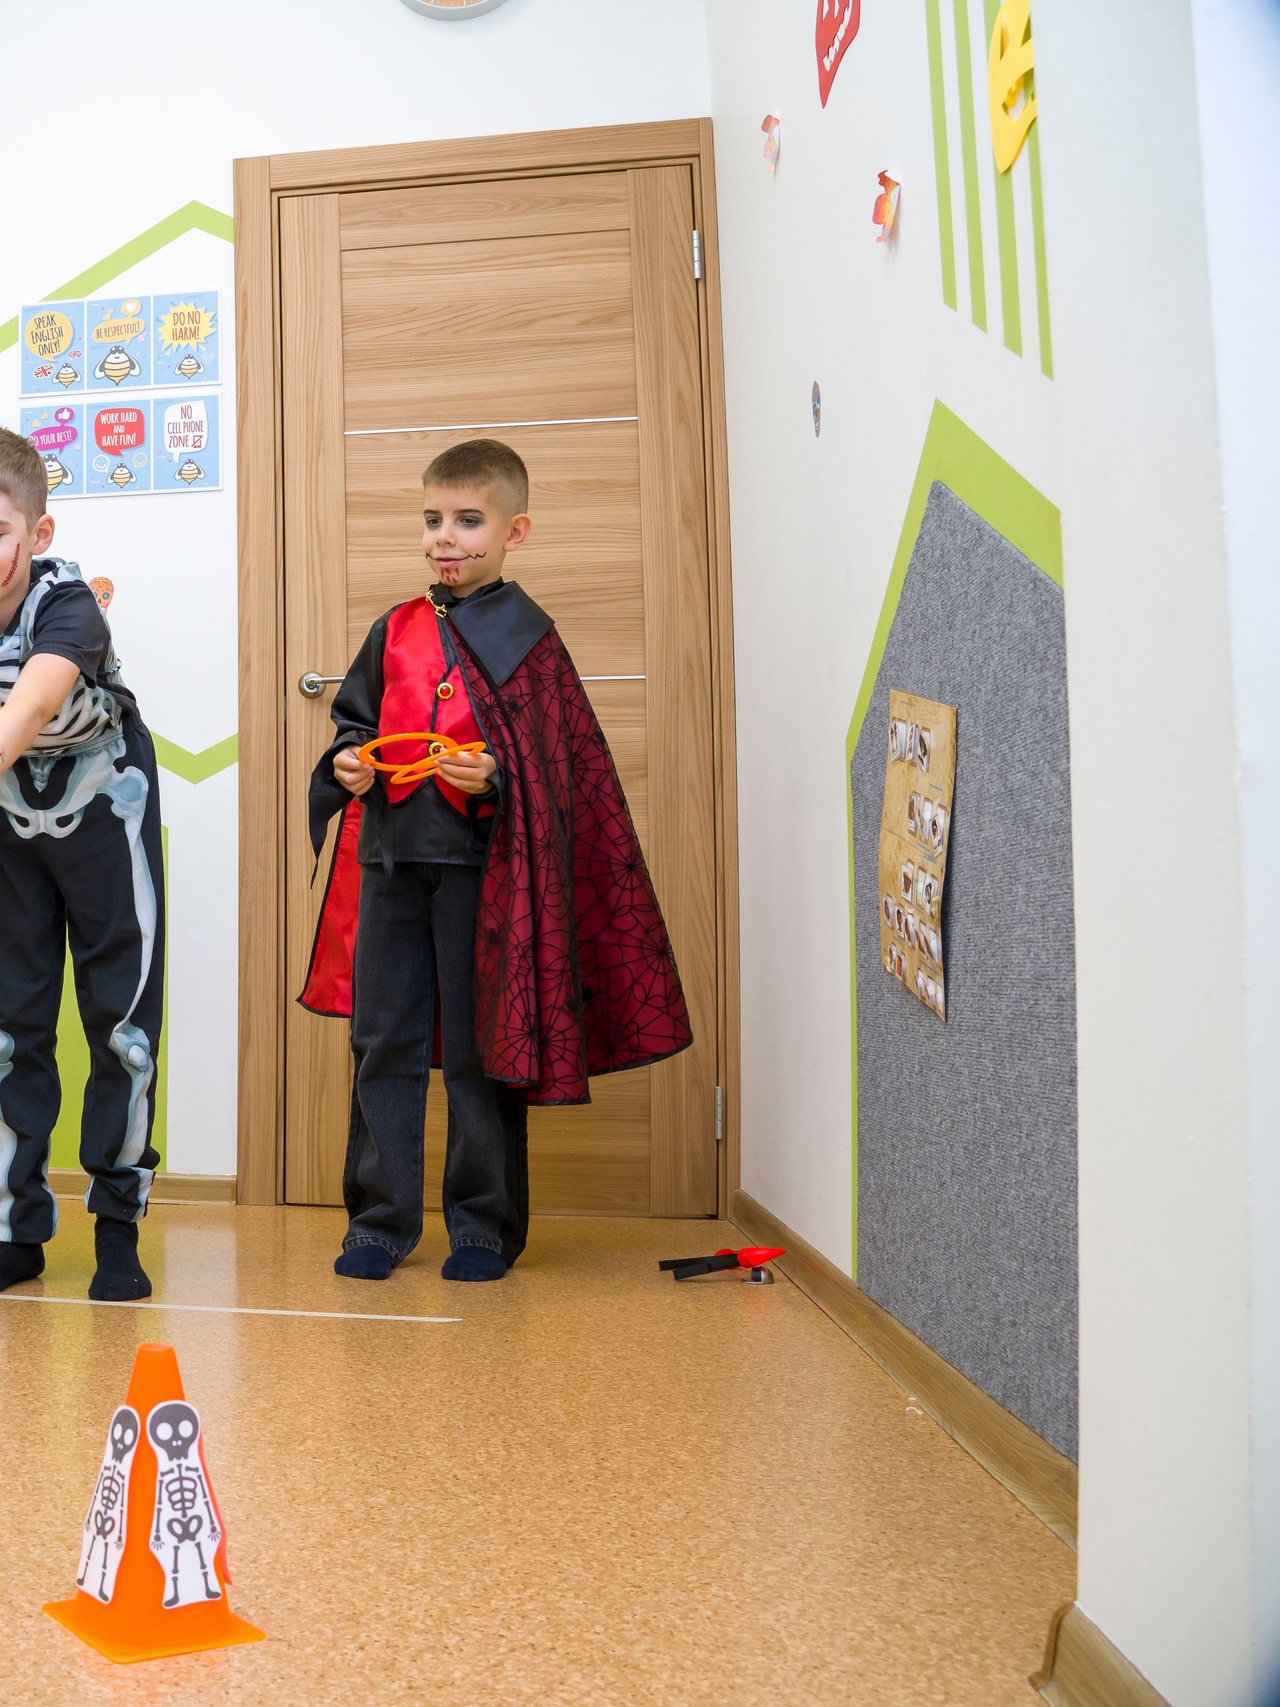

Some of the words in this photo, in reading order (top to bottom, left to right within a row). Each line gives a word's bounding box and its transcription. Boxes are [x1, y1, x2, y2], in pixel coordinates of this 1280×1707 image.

[34, 314, 57, 330] SPEAK
[173, 311, 186, 326] DO
[187, 310, 201, 325] NO
[31, 326, 64, 344] ENGLISH
[96, 328, 103, 339] BE
[104, 321, 140, 338] RESPECTFUL!
[172, 326, 200, 341] HARM!
[38, 339, 61, 356] ONLY!
[100, 412, 120, 425] WORK
[120, 411, 138, 423] HARD
[180, 405, 193, 420] NO
[112, 424, 126, 434] AND
[167, 421, 182, 435] CELL
[183, 420, 204, 433] PHONE
[39, 432, 57, 445] YOUR
[56, 429, 73, 443] BEST!
[101, 435, 119, 447] HAVE
[119, 432, 137, 446] FUN!
[168, 435, 189, 448] ZONE
